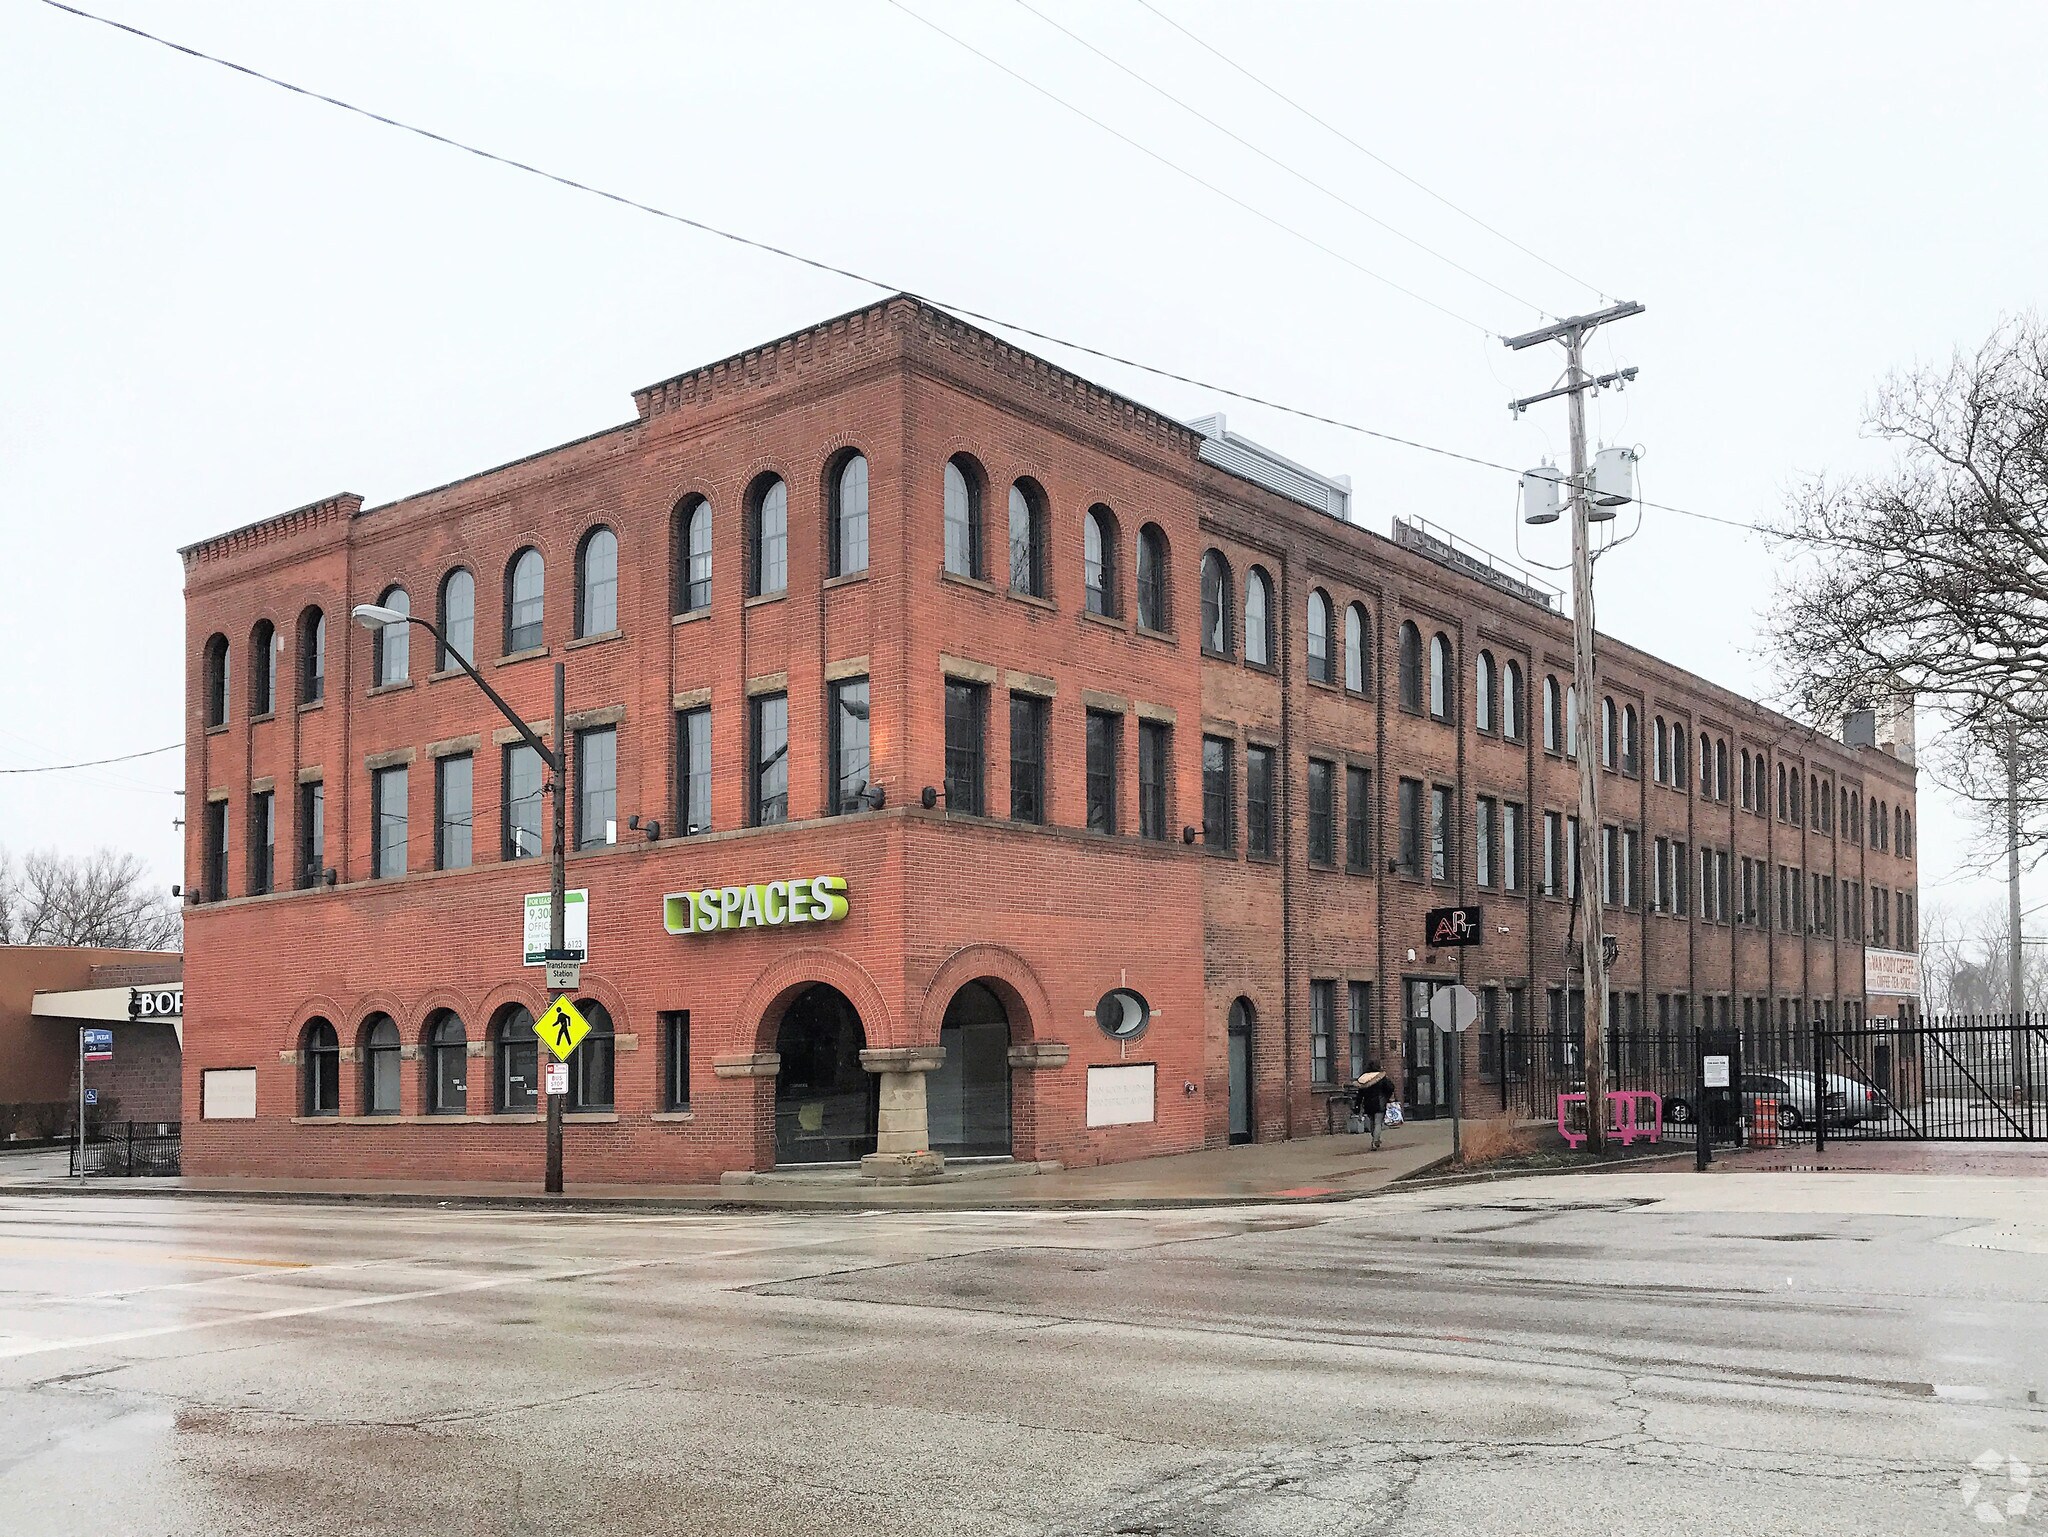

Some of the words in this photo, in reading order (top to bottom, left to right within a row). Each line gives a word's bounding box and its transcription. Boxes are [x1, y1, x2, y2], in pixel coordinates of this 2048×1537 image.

[698, 876, 849, 932] SPACES
[1433, 910, 1476, 942] ART
[568, 940, 582, 948] 6123
[546, 961, 579, 969] Transformer
